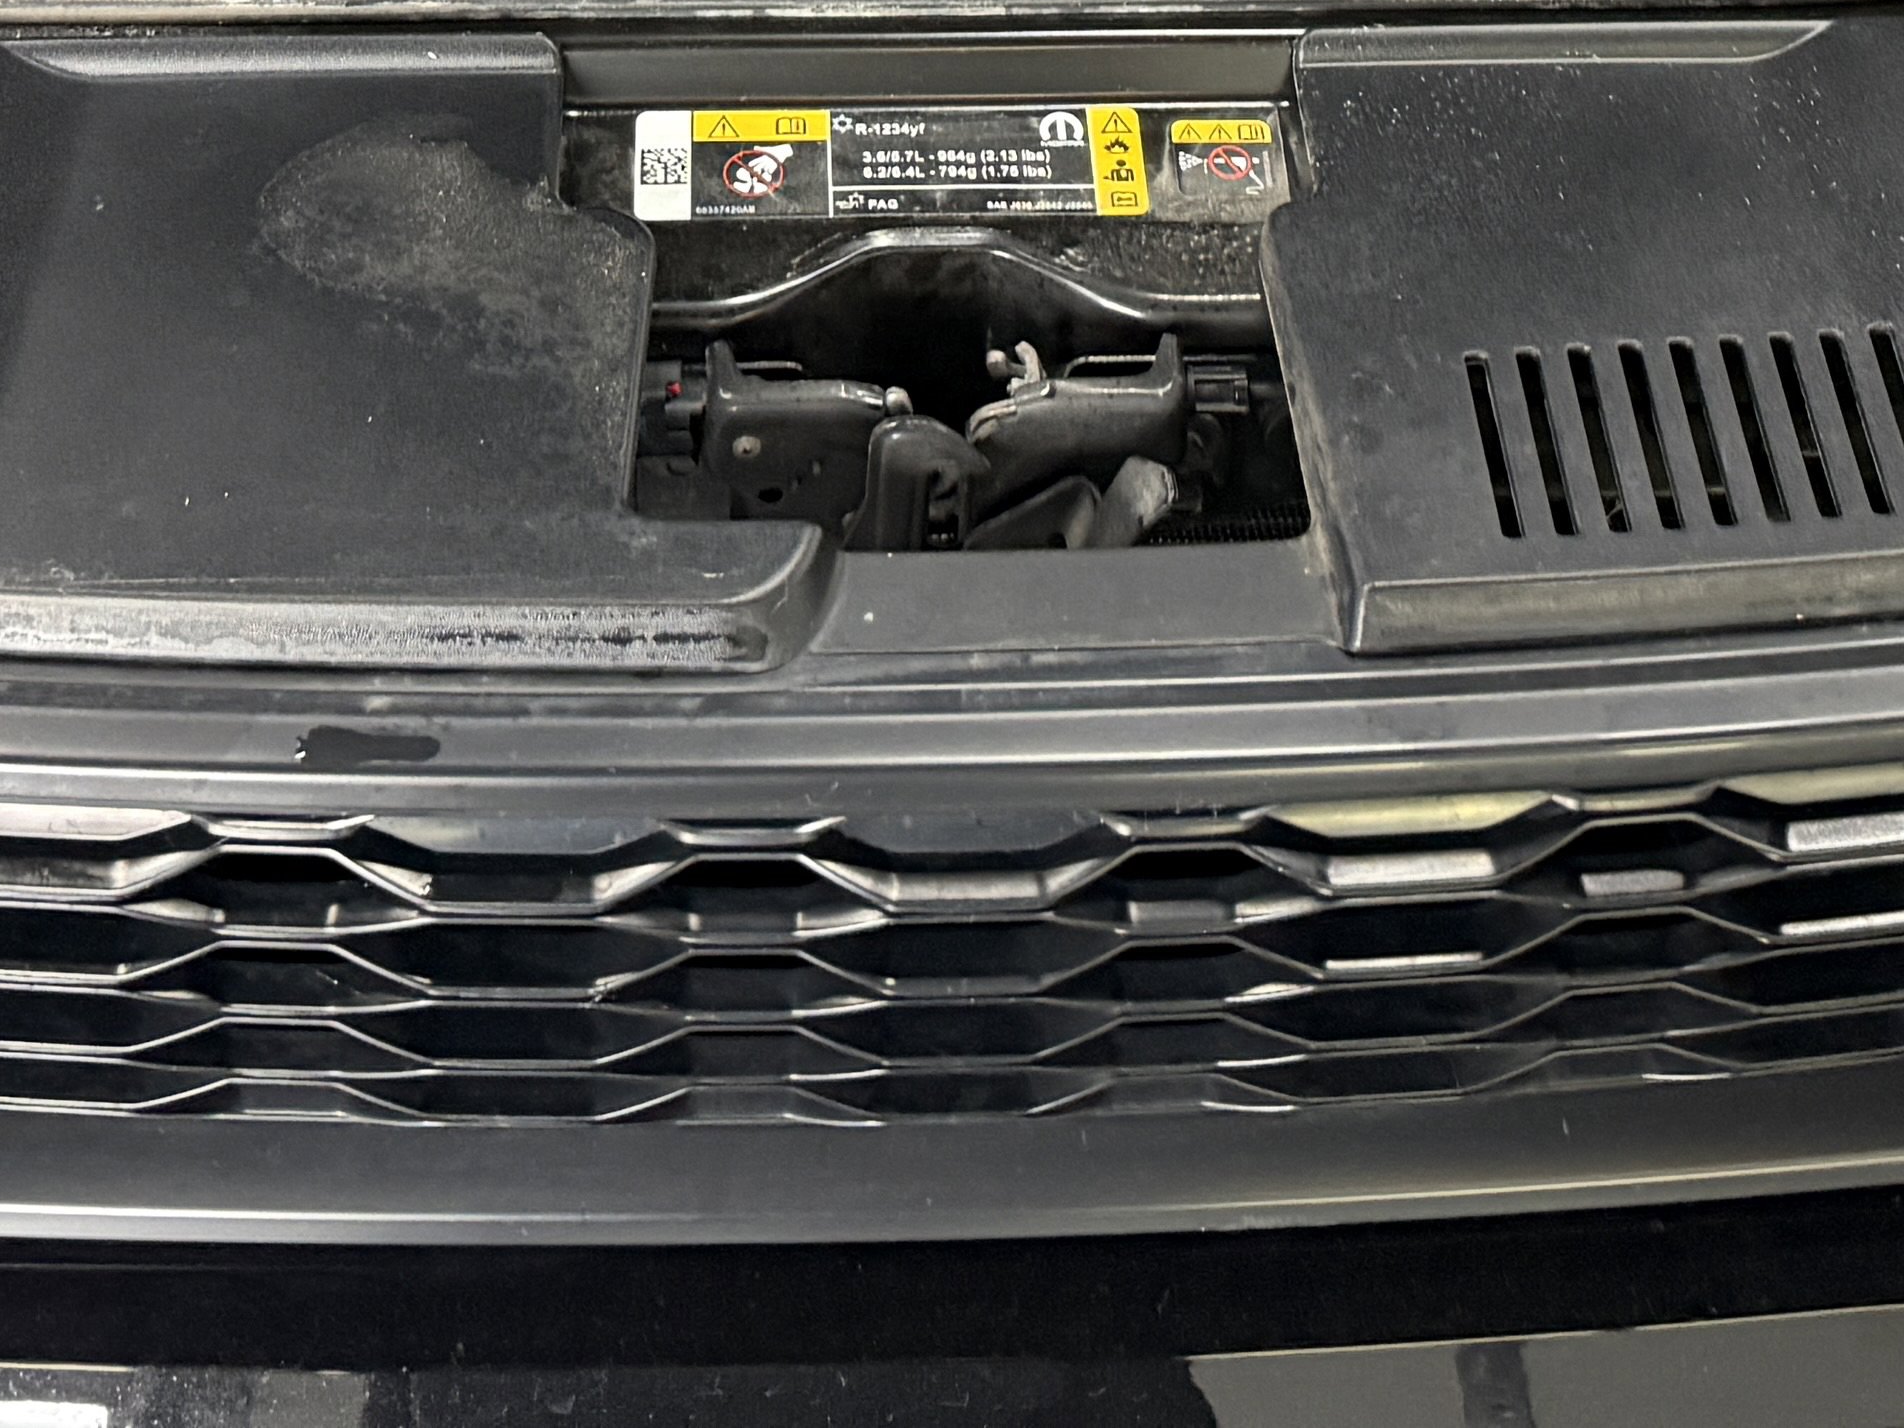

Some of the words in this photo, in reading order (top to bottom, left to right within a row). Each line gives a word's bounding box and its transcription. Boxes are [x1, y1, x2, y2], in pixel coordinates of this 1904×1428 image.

[854, 121, 926, 139] R-1234yf
[981, 149, 1018, 165] (2.13
[1021, 148, 1051, 164] lbs)
[1023, 164, 1053, 180] lbs)
[868, 198, 899, 210] PAG
